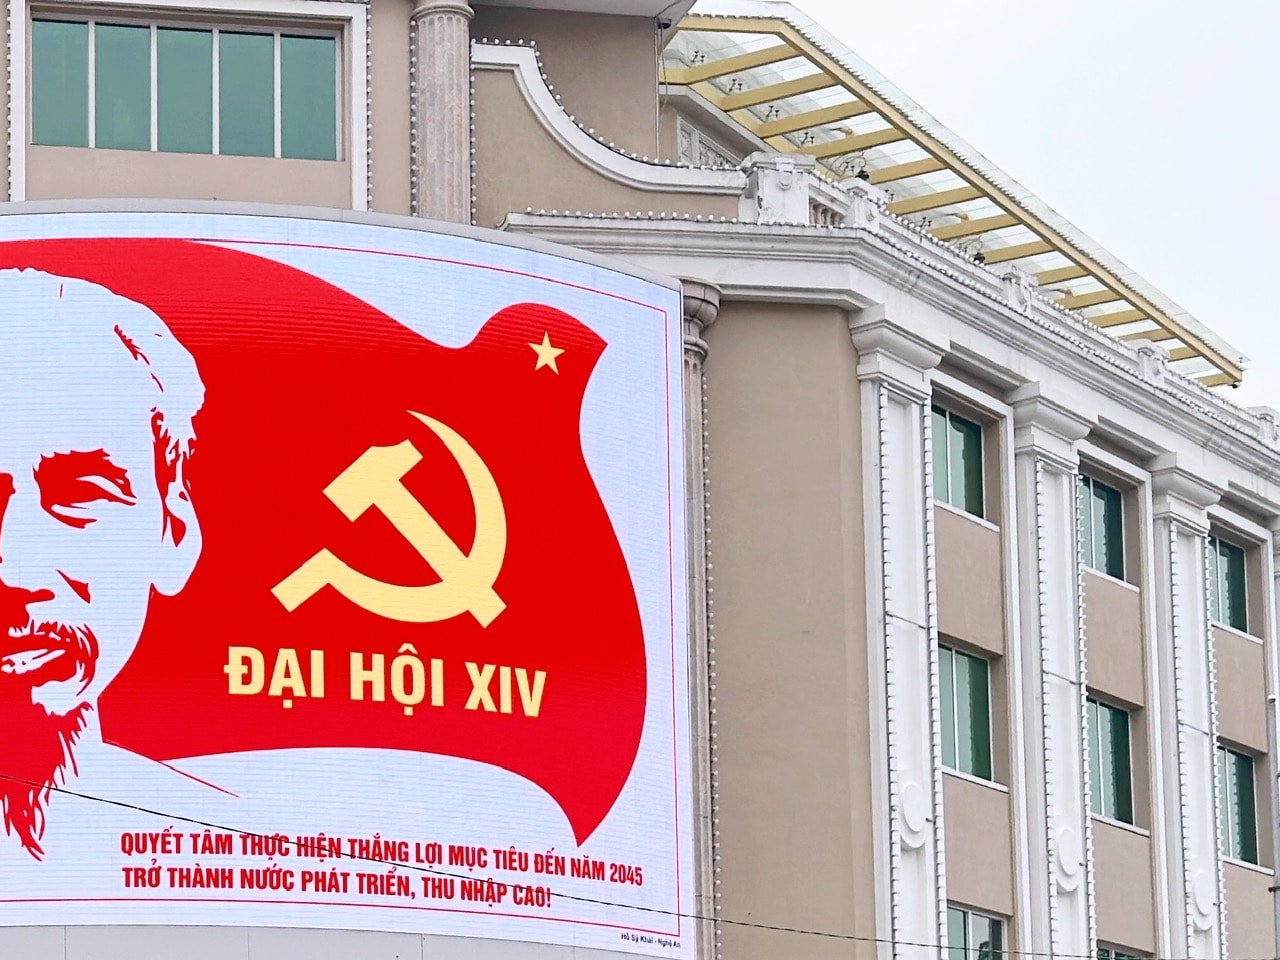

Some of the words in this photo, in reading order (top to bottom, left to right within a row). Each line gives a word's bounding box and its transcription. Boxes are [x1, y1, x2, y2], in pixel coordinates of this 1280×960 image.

[223, 645, 325, 709] ĐẠI
[350, 642, 445, 716] HỘI
[464, 661, 547, 718] XIV
[121, 826, 183, 857] QUYẾT
[190, 829, 233, 855] TÂM
[239, 833, 290, 861] THỰC
[296, 832, 342, 862] HIỆN
[348, 833, 410, 862] THẮNG
[415, 842, 443, 868] LỢI
[449, 845, 488, 872] MỤC
[493, 846, 529, 872] TIÊU
[534, 847, 566, 875] ĐẾN
[571, 855, 605, 880] NĂM
[609, 863, 643, 886] 2045
[122, 858, 162, 888] TRỞ
[167, 863, 234, 889] THÀNH
[240, 863, 295, 891] NƯỚC
[301, 867, 351, 894] PHÁT
[356, 866, 416, 900] TRIỂN,
[421, 876, 455, 900] THU
[460, 878, 508, 907] NHẬP
[512, 884, 551, 908] CAO!
